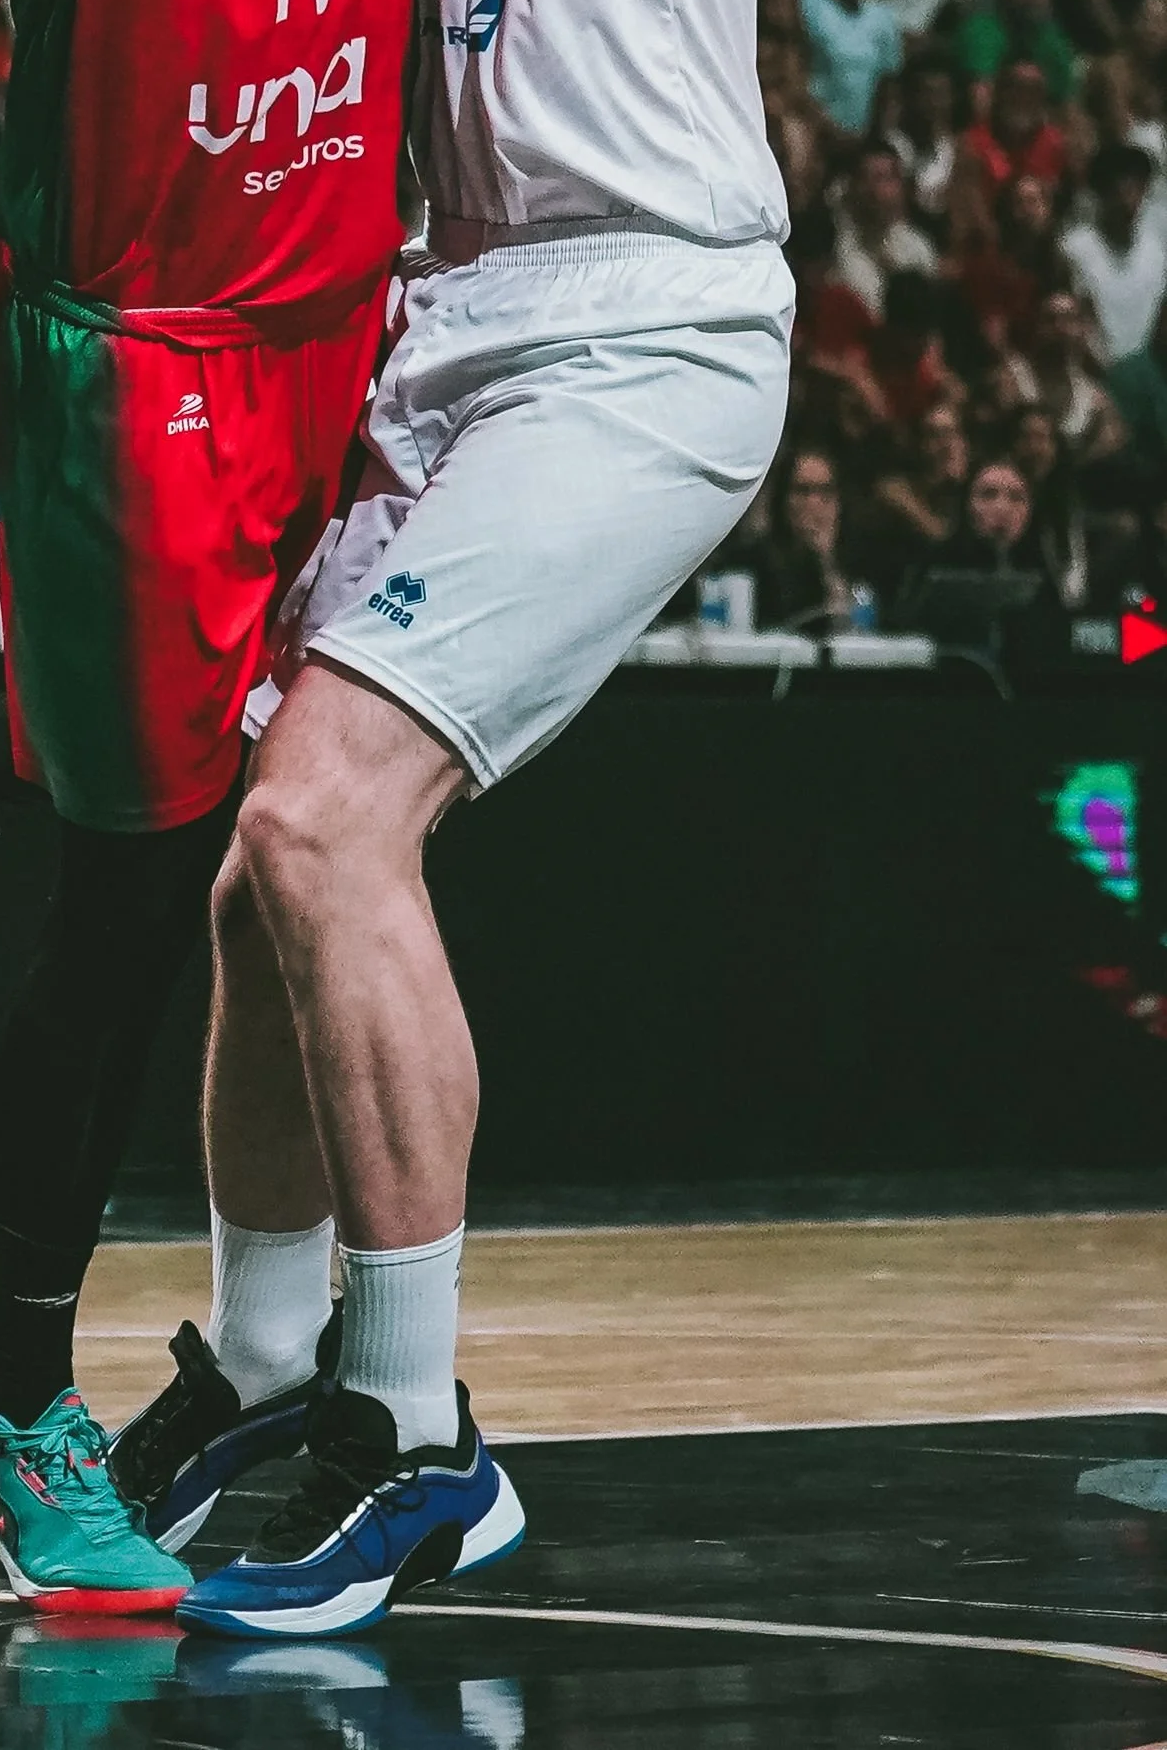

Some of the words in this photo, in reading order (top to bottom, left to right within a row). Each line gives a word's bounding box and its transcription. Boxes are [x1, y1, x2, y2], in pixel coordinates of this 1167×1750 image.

[187, 36, 366, 154] una
[242, 135, 365, 195] seuros
[167, 416, 210, 435] DHIKA
[368, 593, 414, 630] errea
